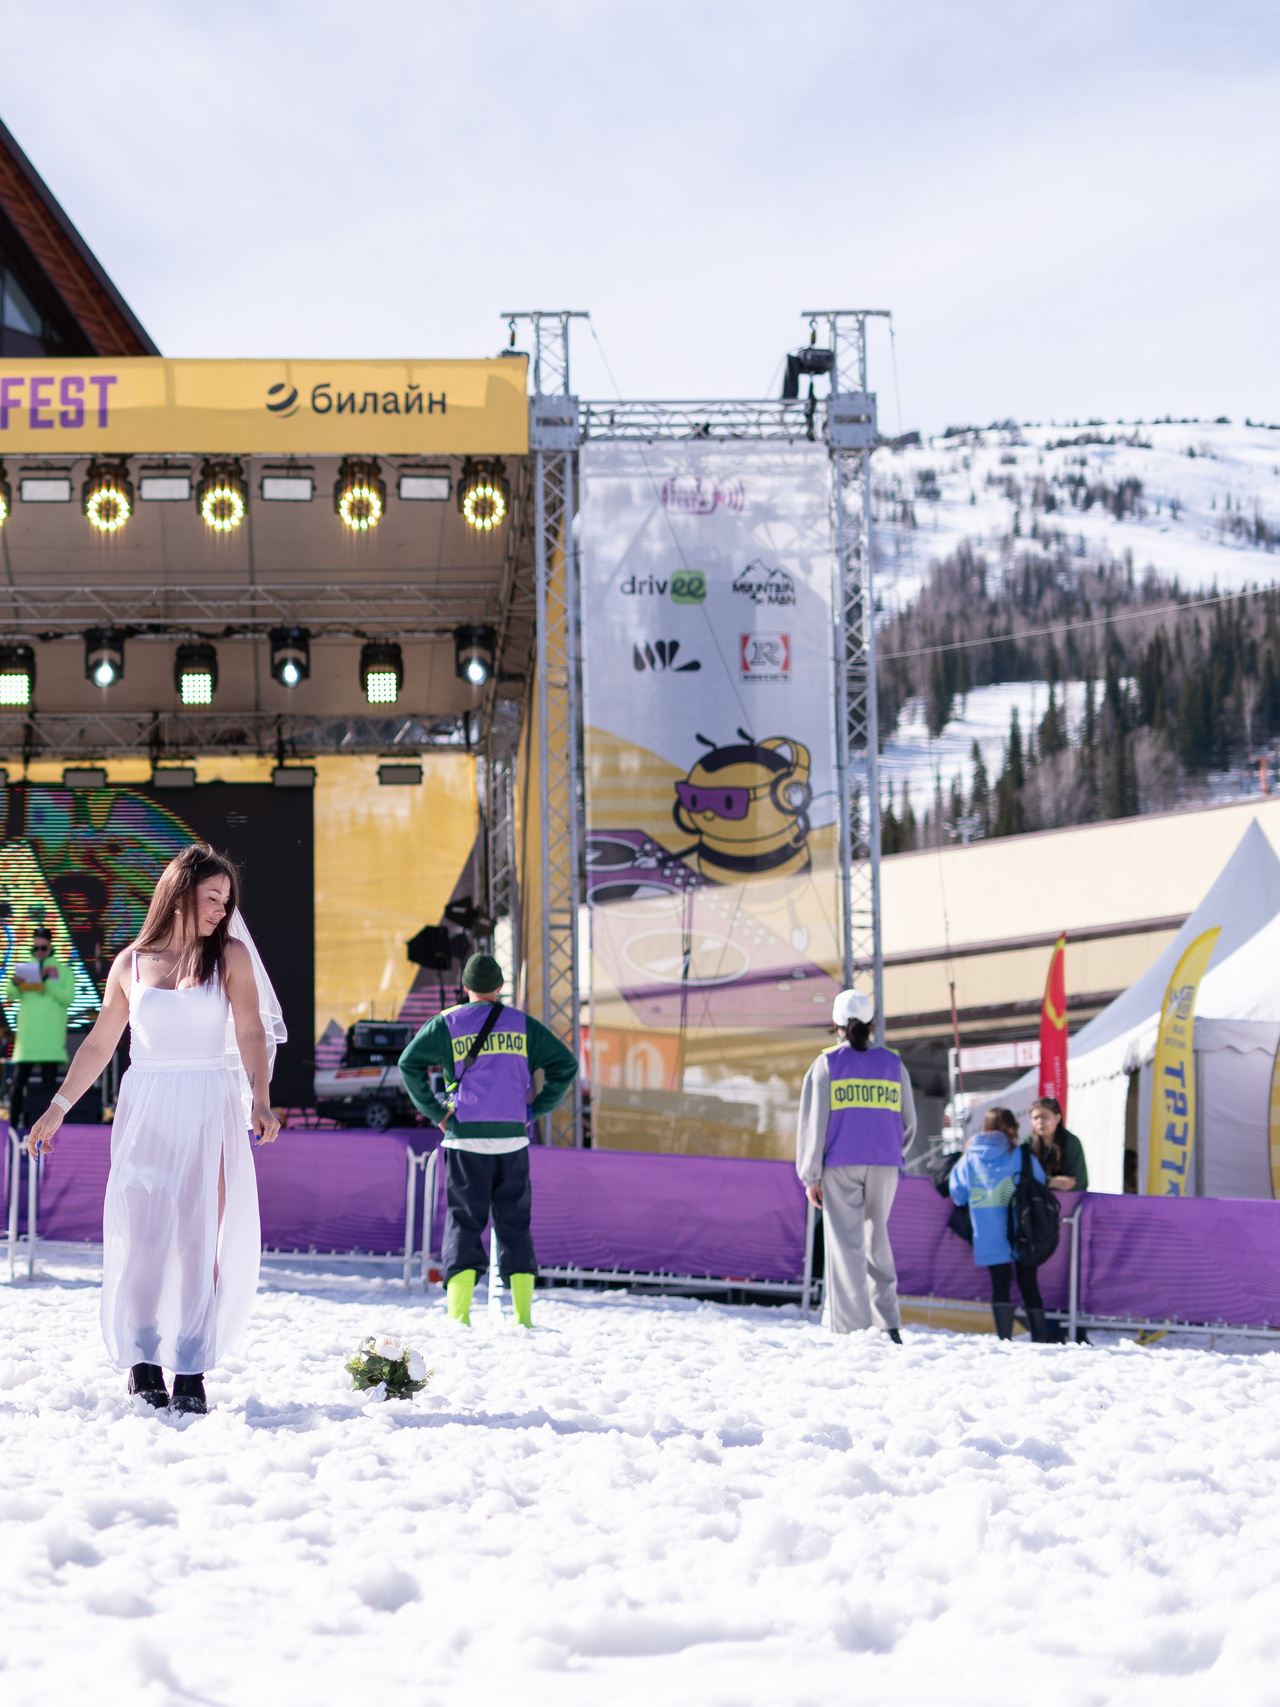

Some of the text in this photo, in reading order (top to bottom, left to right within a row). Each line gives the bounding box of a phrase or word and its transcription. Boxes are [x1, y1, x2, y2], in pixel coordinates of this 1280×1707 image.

[311, 383, 447, 415] билайн
[620, 574, 707, 600] drivee
[454, 1033, 524, 1056] ФООГРАФ
[834, 1083, 900, 1105] ФОТОГРАФ
